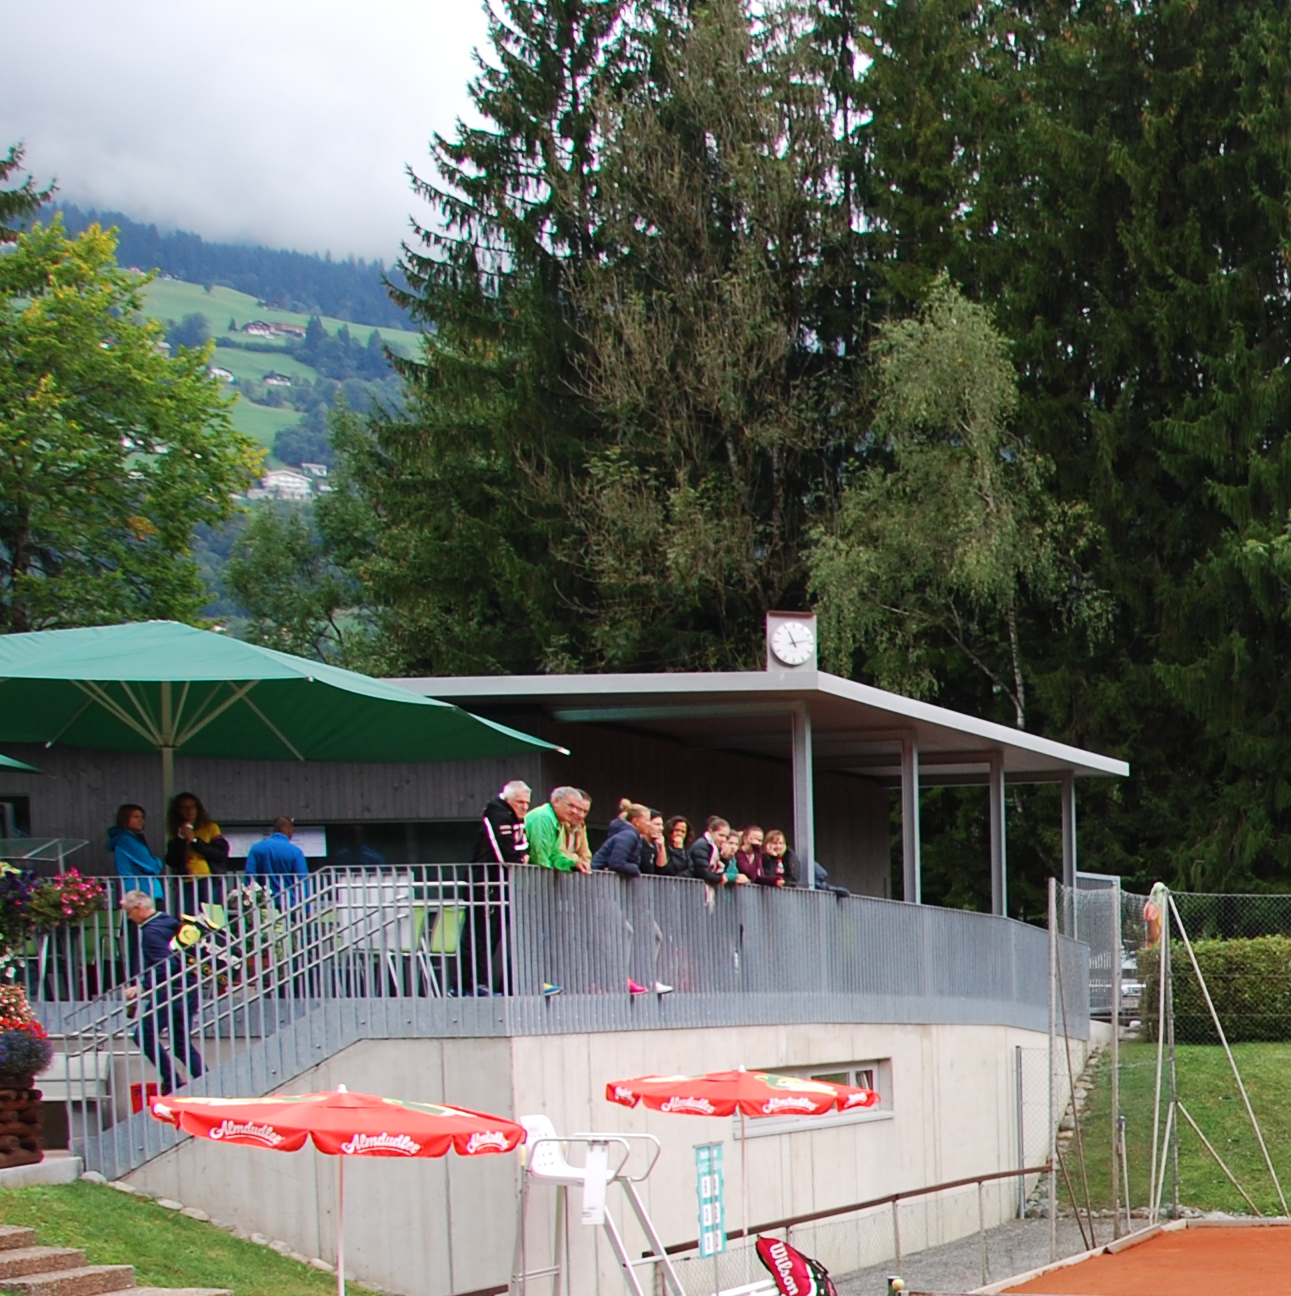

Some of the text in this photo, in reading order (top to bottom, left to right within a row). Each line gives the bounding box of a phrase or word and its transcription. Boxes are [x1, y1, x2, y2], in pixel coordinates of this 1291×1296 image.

[209, 1119, 285, 1147] Almdudler
[341, 1132, 422, 1156] Almdudler
[769, 1241, 799, 1296] Wilson
